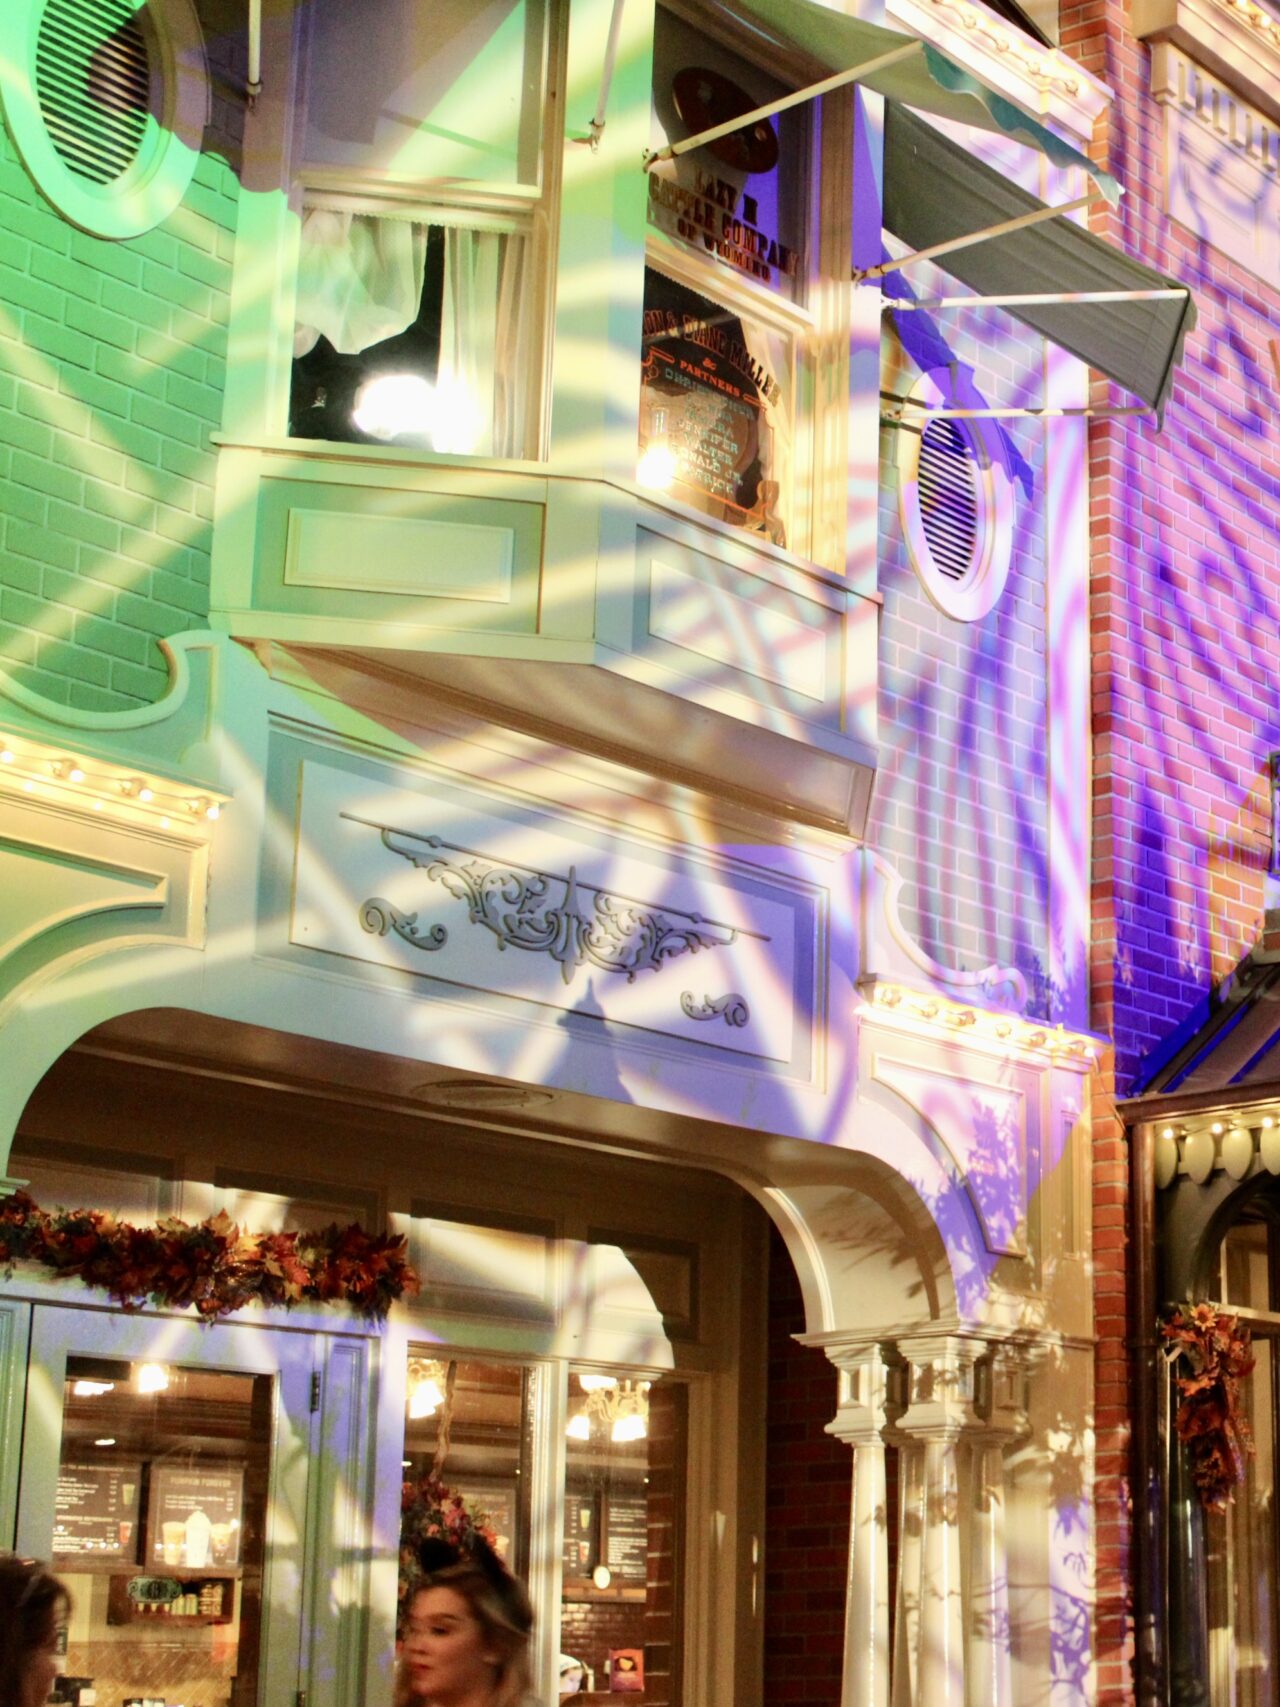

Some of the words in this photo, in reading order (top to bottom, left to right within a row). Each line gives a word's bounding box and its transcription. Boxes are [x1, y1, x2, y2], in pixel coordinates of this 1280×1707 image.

[722, 212, 800, 277] COMPANY
[680, 360, 741, 397] PARTNERS
[702, 357, 717, 371] &
